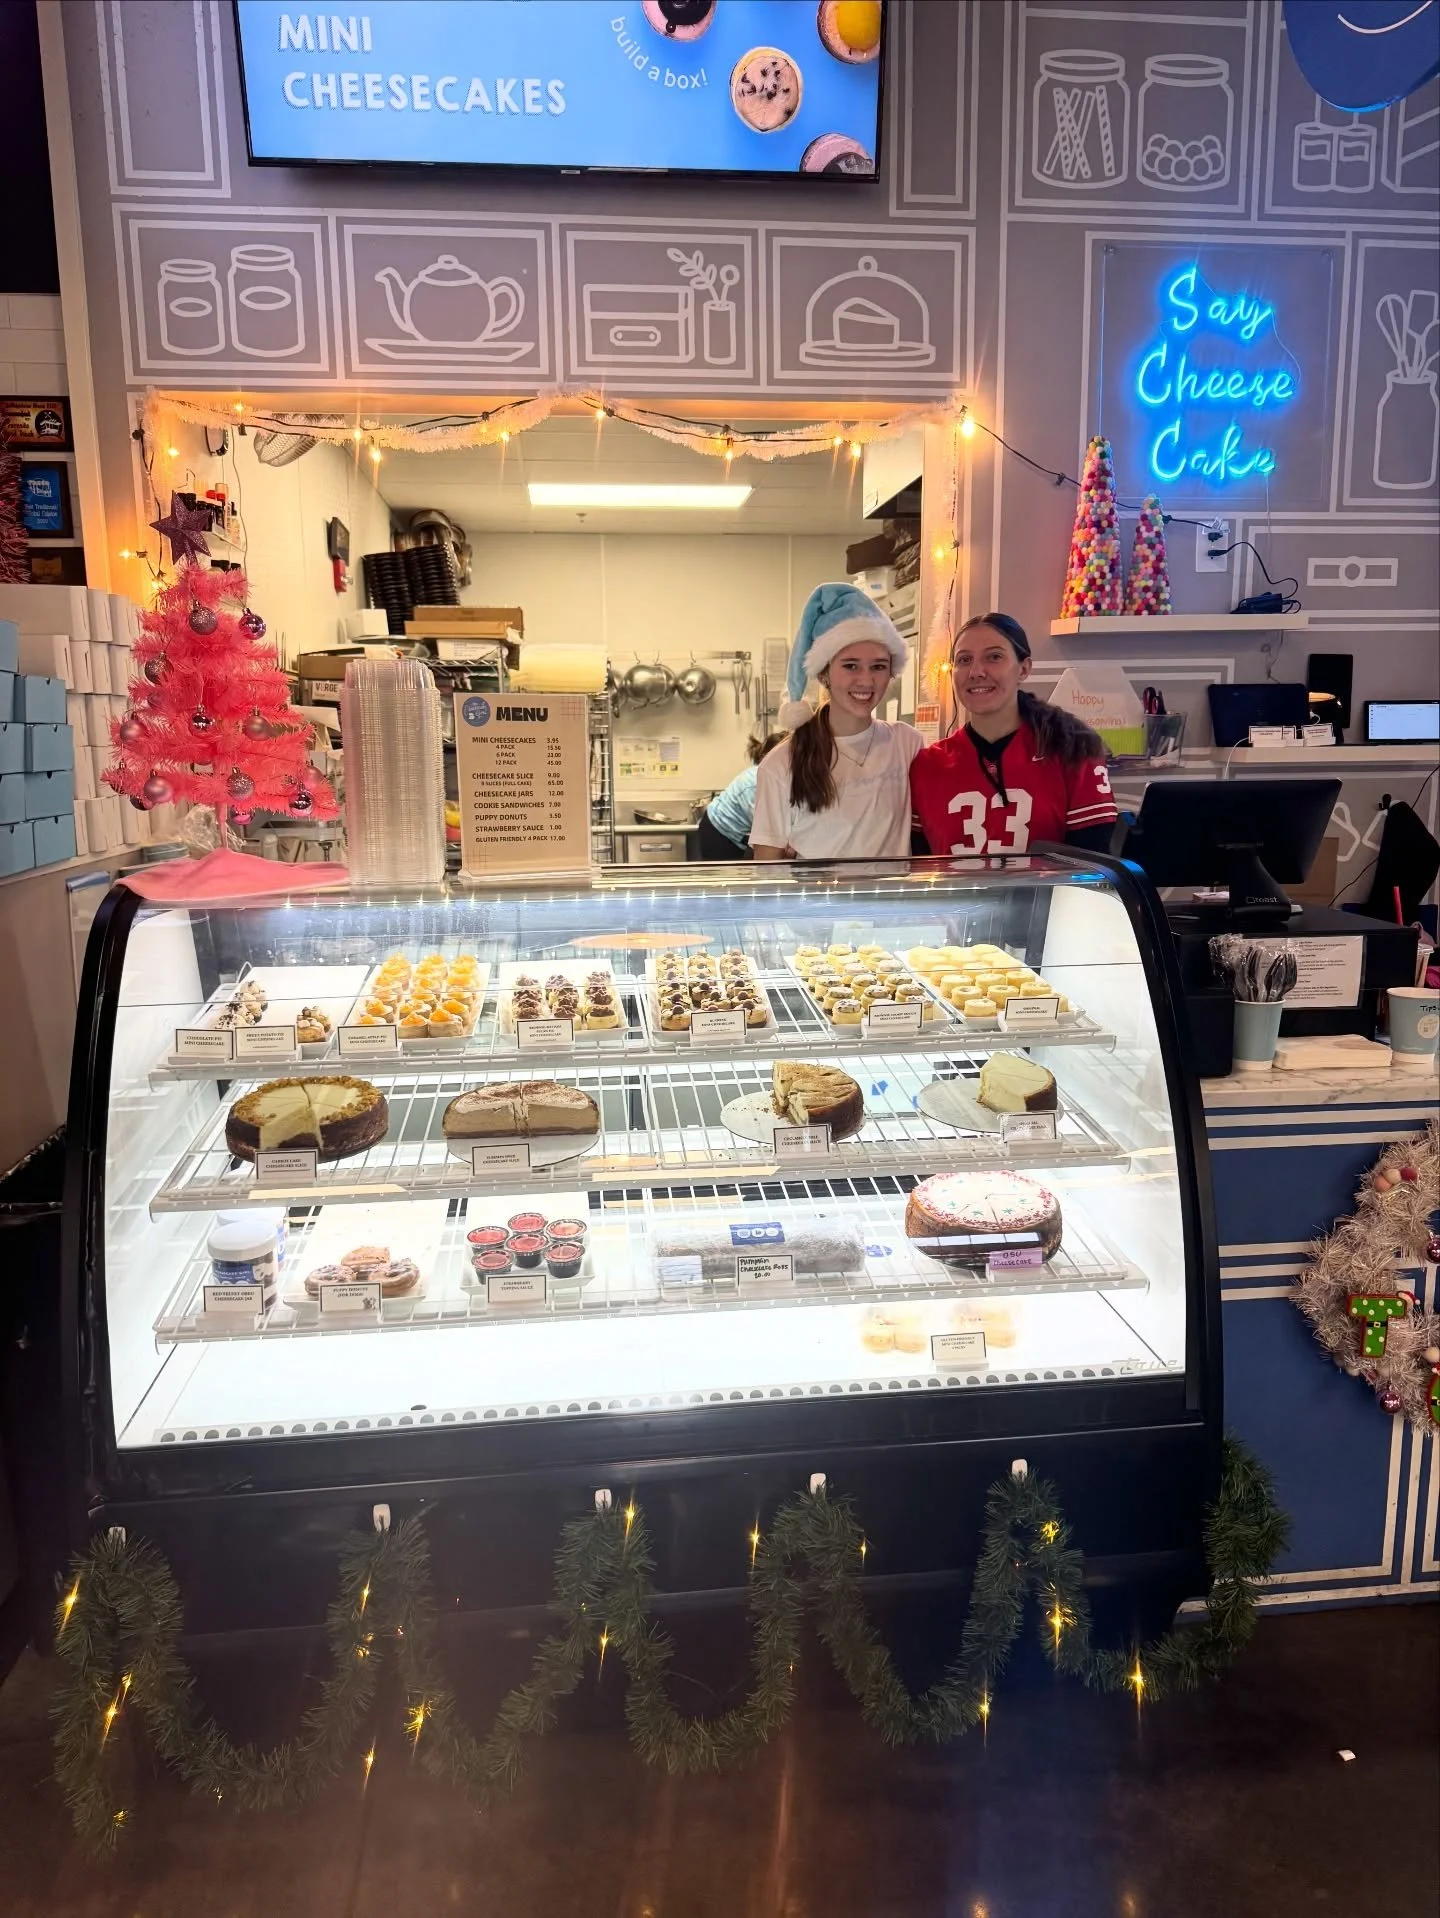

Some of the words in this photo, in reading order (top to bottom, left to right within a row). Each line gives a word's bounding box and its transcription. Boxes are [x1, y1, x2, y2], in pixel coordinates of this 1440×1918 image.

[278, 14, 373, 54] MINI
[610, 16, 649, 71] build
[648, 66, 660, 81] a
[664, 68, 708, 90] box!
[283, 70, 566, 117] CHEESECAKES
[1168, 266, 1272, 340] Say
[1137, 343, 1294, 406] Cheese
[1152, 418, 1276, 480] Cake
[496, 706, 548, 722] MENU
[1072, 689, 1105, 713] Happy
[1094, 766, 1111, 794] 3
[948, 788, 1032, 854] 33
